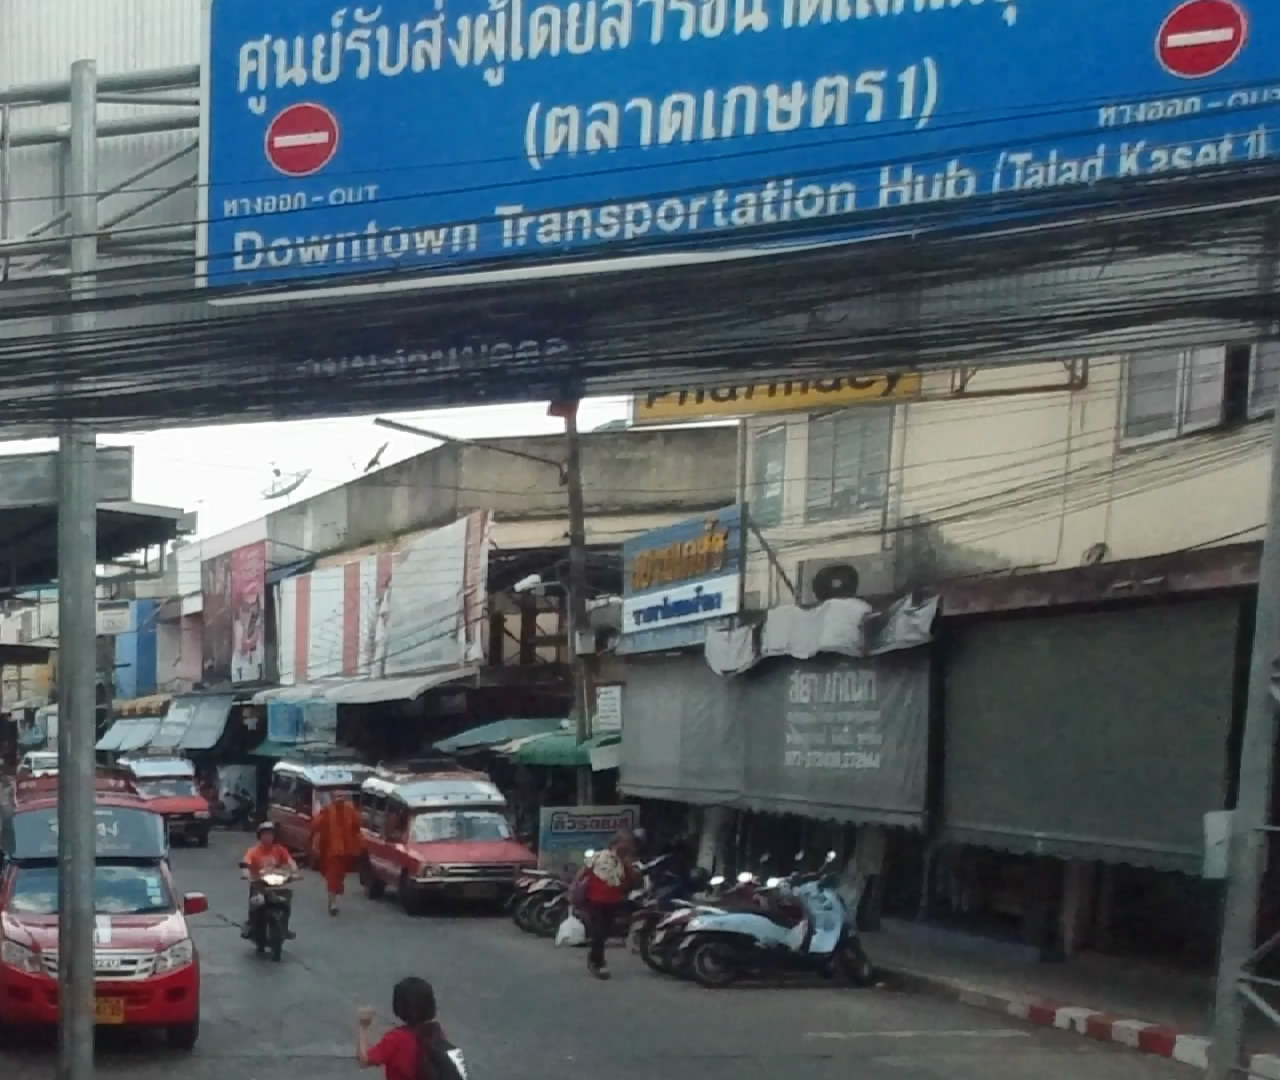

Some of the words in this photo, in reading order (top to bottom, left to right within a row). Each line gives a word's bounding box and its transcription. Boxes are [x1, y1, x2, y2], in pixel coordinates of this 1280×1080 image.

[1098, 96, 1201, 128] ทางออก
[223, 191, 307, 218] ทางออก
[329, 184, 379, 206] OUT
[233, 219, 479, 272] Downtown
[495, 178, 856, 248] Transportation
[878, 159, 977, 208] Hub
